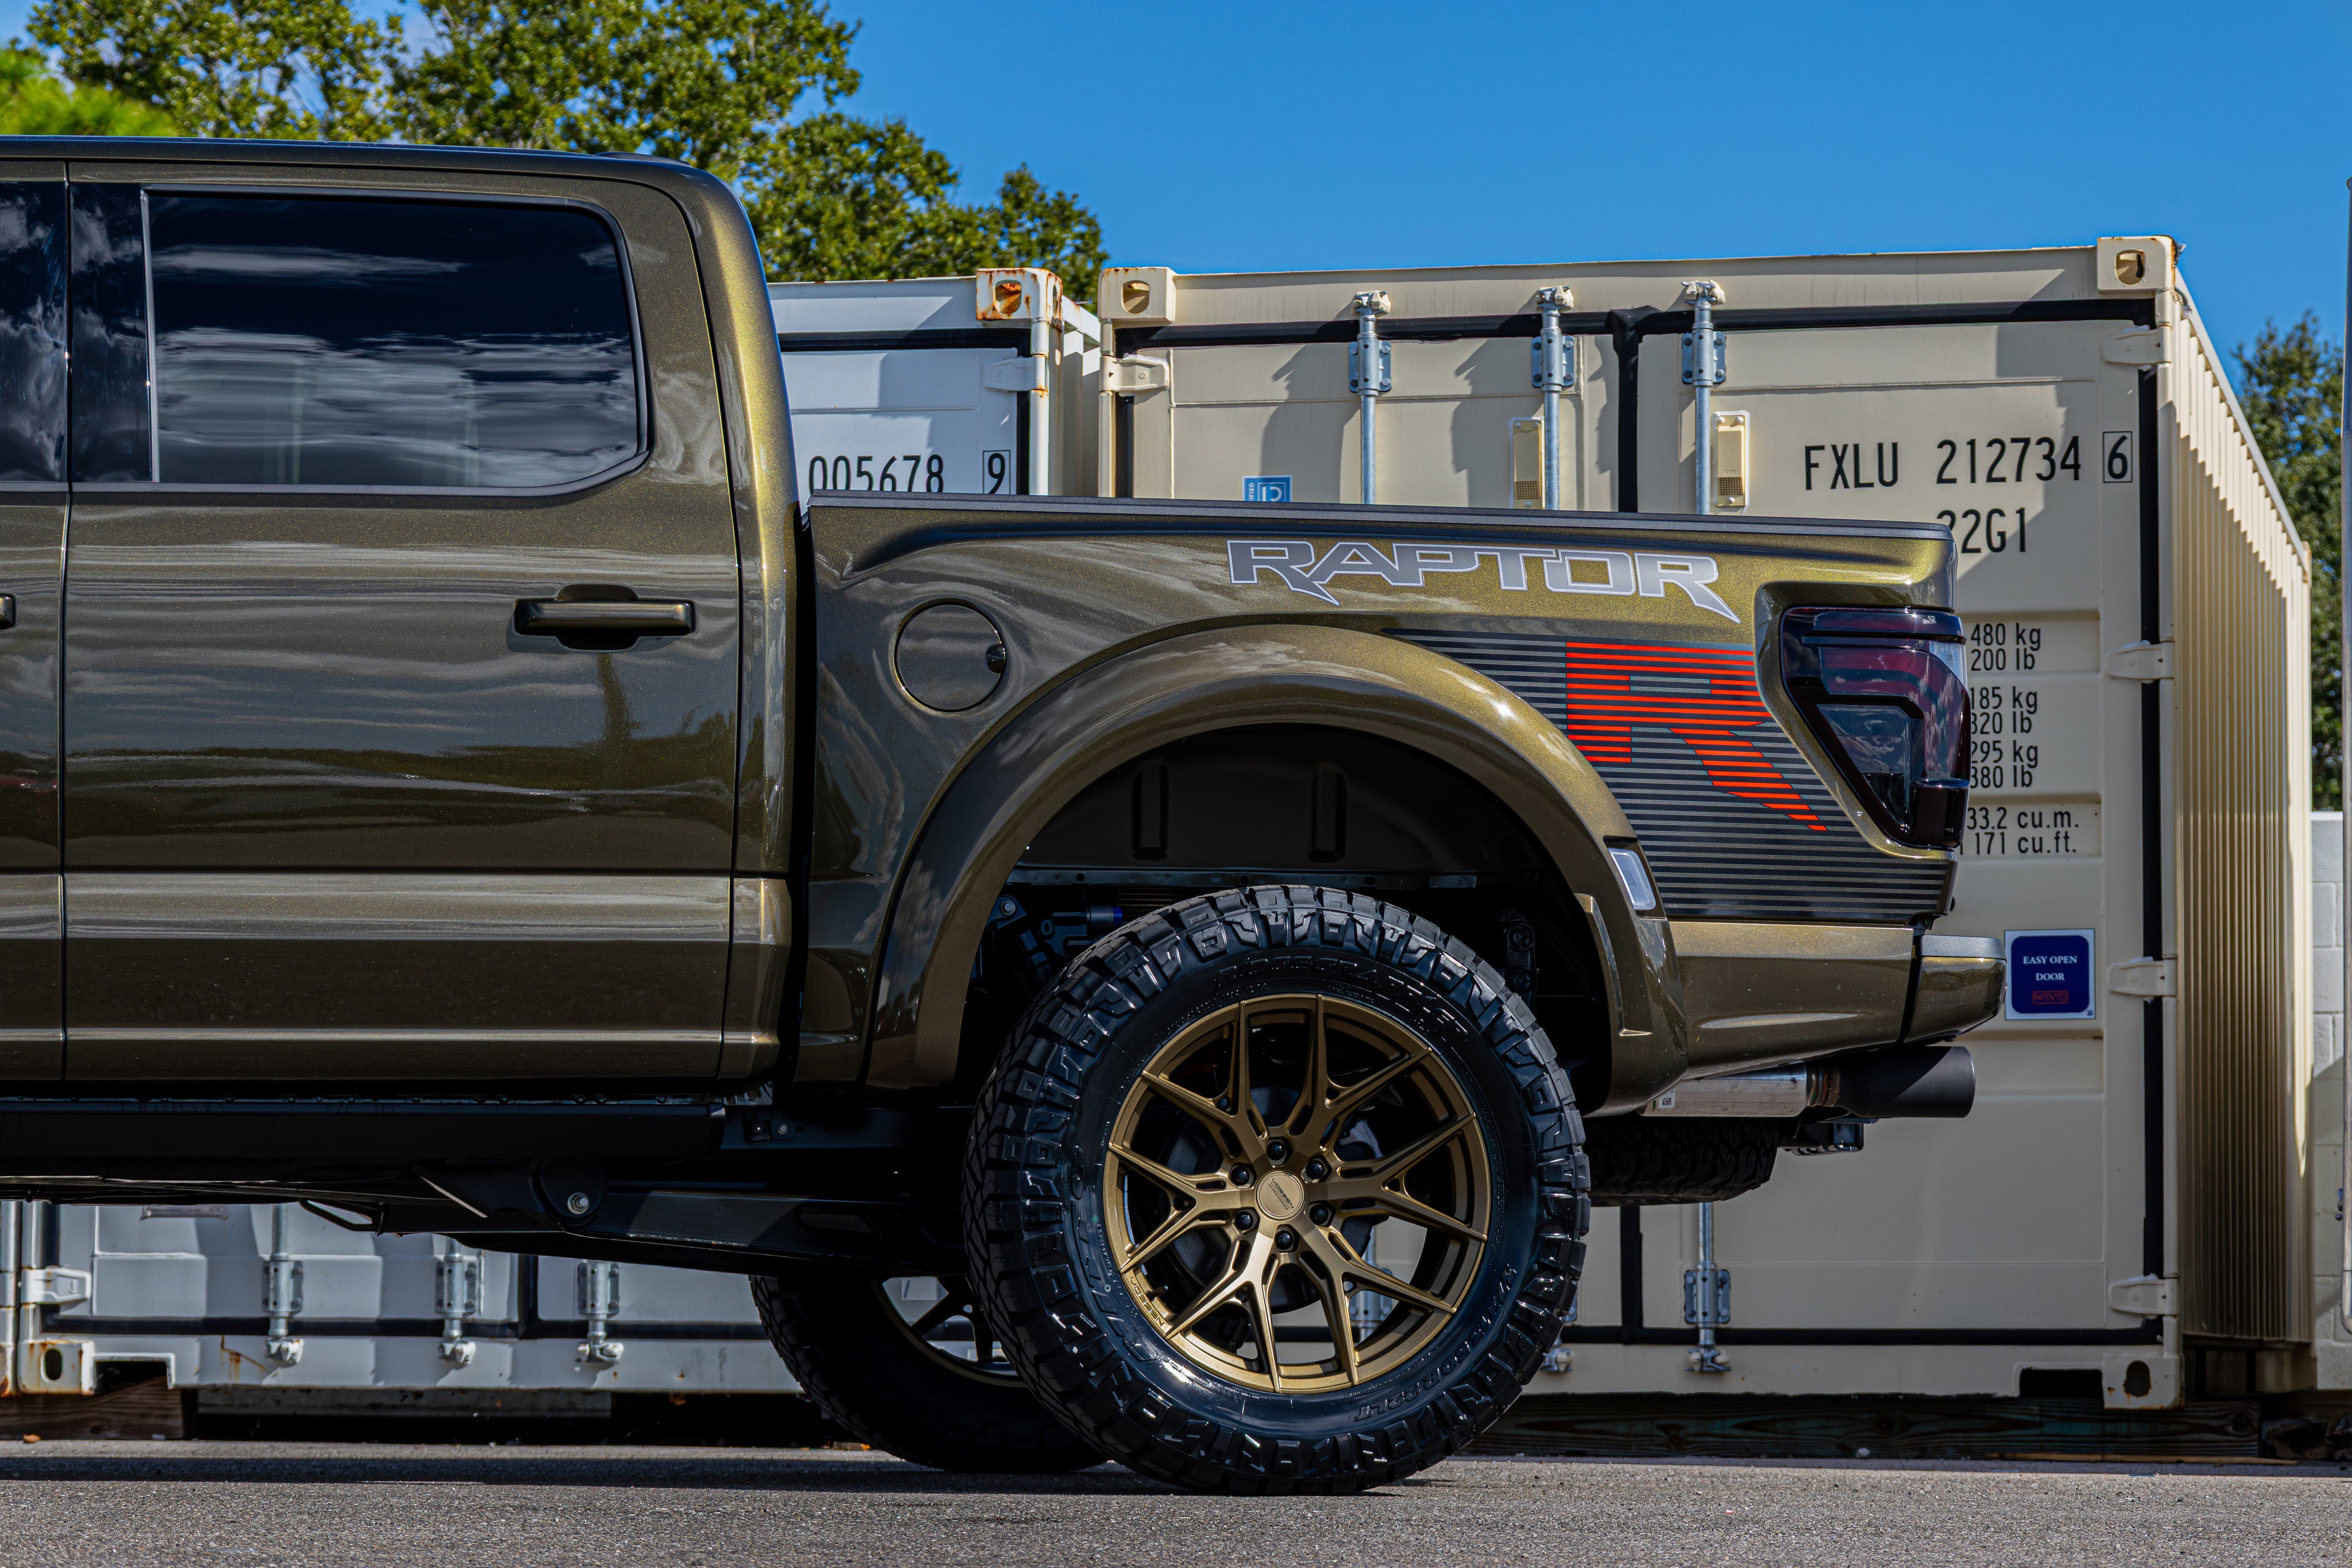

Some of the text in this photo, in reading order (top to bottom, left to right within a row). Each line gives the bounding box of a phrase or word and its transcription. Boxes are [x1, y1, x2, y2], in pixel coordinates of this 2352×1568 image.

[809, 453, 1005, 493] 005678 9
[1805, 435, 2128, 490] FXLU 212734 6
[1226, 540, 1741, 624] RAPTOR
[1971, 622, 2041, 651] 480 kg
[1971, 647, 2036, 671] 200 lb
[1970, 686, 2037, 715] 185 kg
[2013, 711, 2032, 733] lb
[2013, 739, 2038, 768] kg
[2013, 765, 2033, 787] lb
[1967, 806, 2078, 830] 33.2 cu.m.
[2018, 831, 2076, 853] cu.ft.
[2023, 956, 2077, 964] EASY OPEN
[2036, 972, 2065, 981] DOOR
[1272, 1178, 1294, 1209] VOSSEN
[1130, 1277, 1165, 1327] VOSSEN
